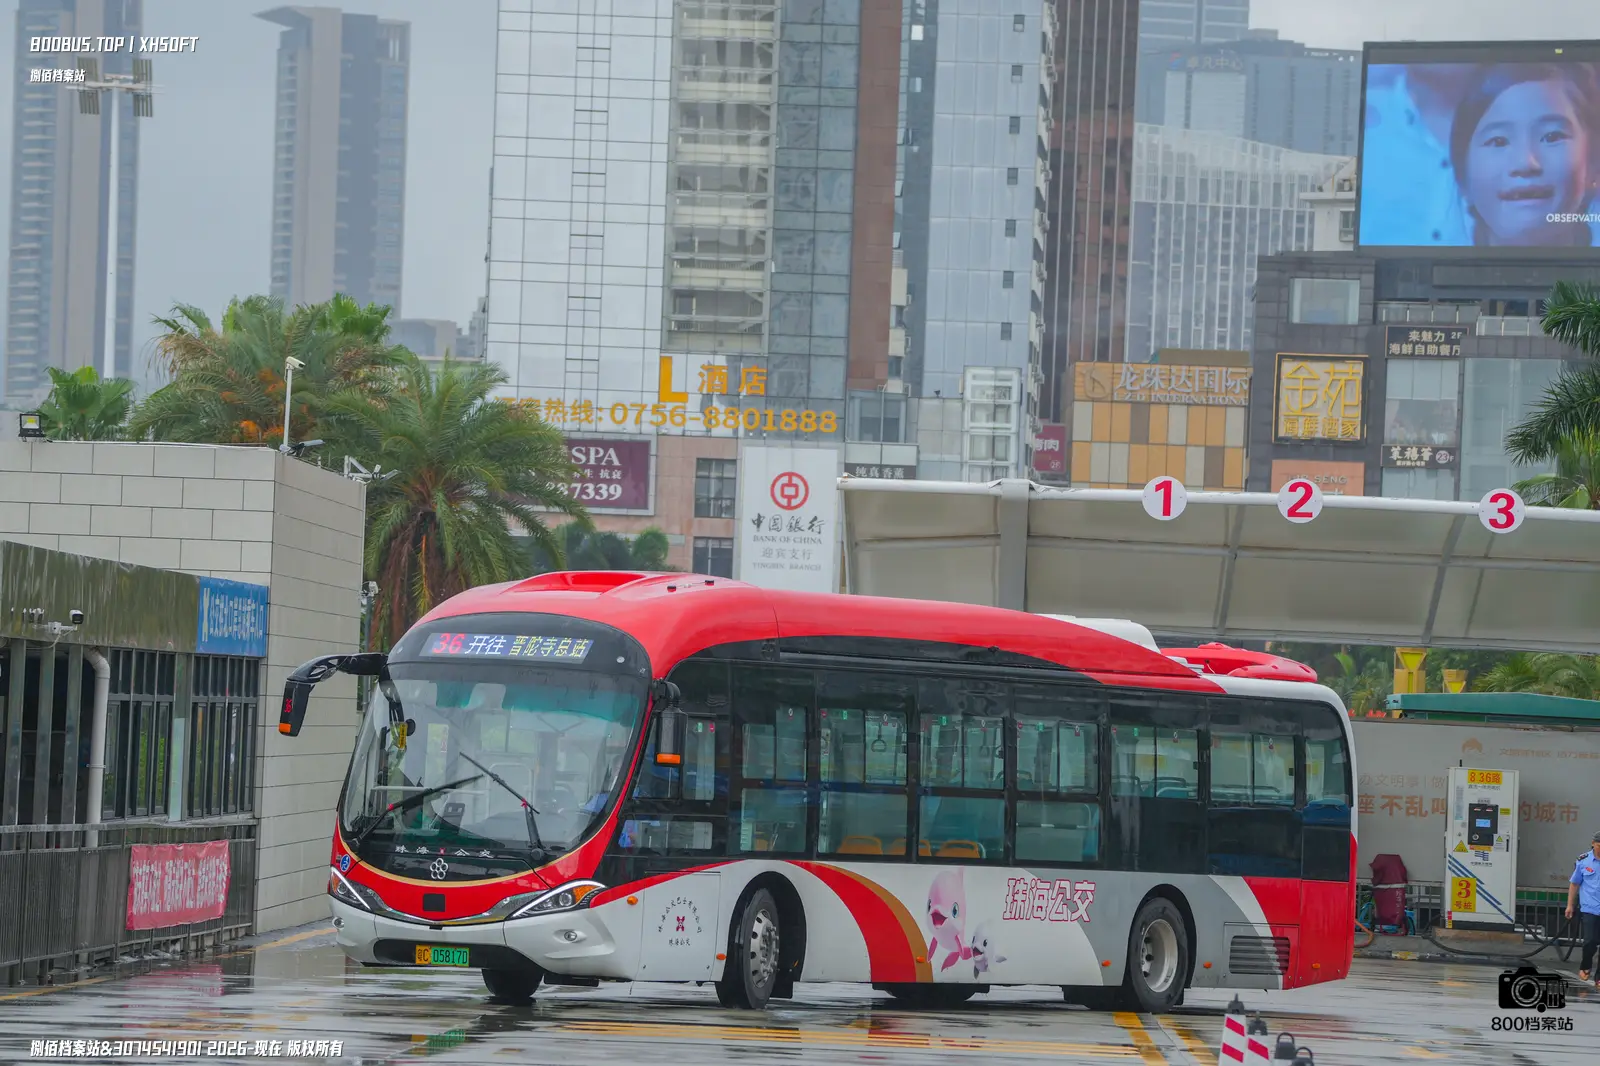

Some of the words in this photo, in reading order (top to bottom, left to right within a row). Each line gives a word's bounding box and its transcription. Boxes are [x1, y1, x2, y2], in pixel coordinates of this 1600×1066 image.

[659, 356, 689, 403] L
[698, 363, 768, 396] 酒店
[1114, 364, 1249, 394] 龙珠达国际
[1283, 362, 1361, 418] 金苑
[571, 446, 621, 466] SPA
[1155, 480, 1172, 516] 1
[1287, 481, 1313, 518] 2
[1489, 493, 1515, 529] 3
[752, 535, 777, 543] BANK
[779, 535, 791, 543] OF
[793, 536, 822, 545] CHINA
[433, 633, 466, 654] 36
[464, 635, 507, 655] 开往
[1002, 878, 1096, 922] 珠海公交
[1455, 900, 1473, 910] 号桩
[1457, 879, 1471, 899] 3
